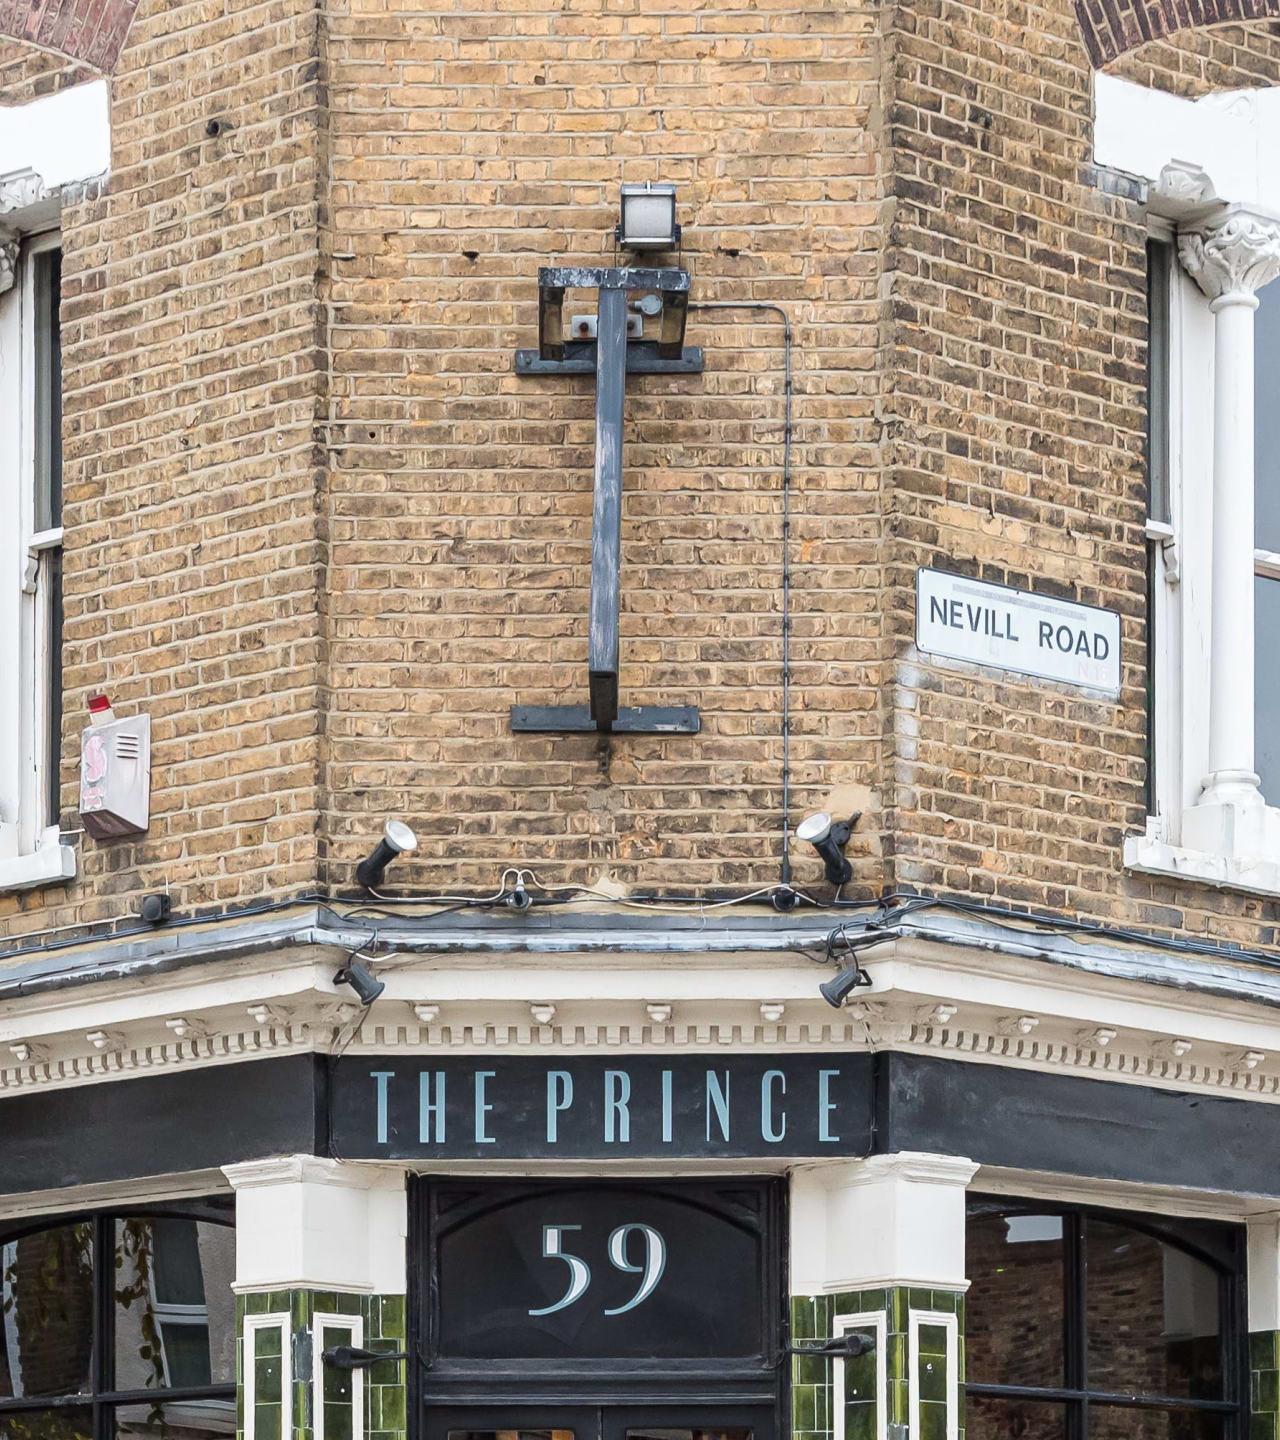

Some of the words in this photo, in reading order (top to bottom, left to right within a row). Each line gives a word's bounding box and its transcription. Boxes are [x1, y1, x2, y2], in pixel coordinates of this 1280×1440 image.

[930, 596, 1019, 642] NEVILL
[1039, 620, 1109, 661] ROAD
[370, 1071, 496, 1144] THE
[547, 1070, 840, 1142] PRINCE
[528, 1223, 667, 1316] 59
